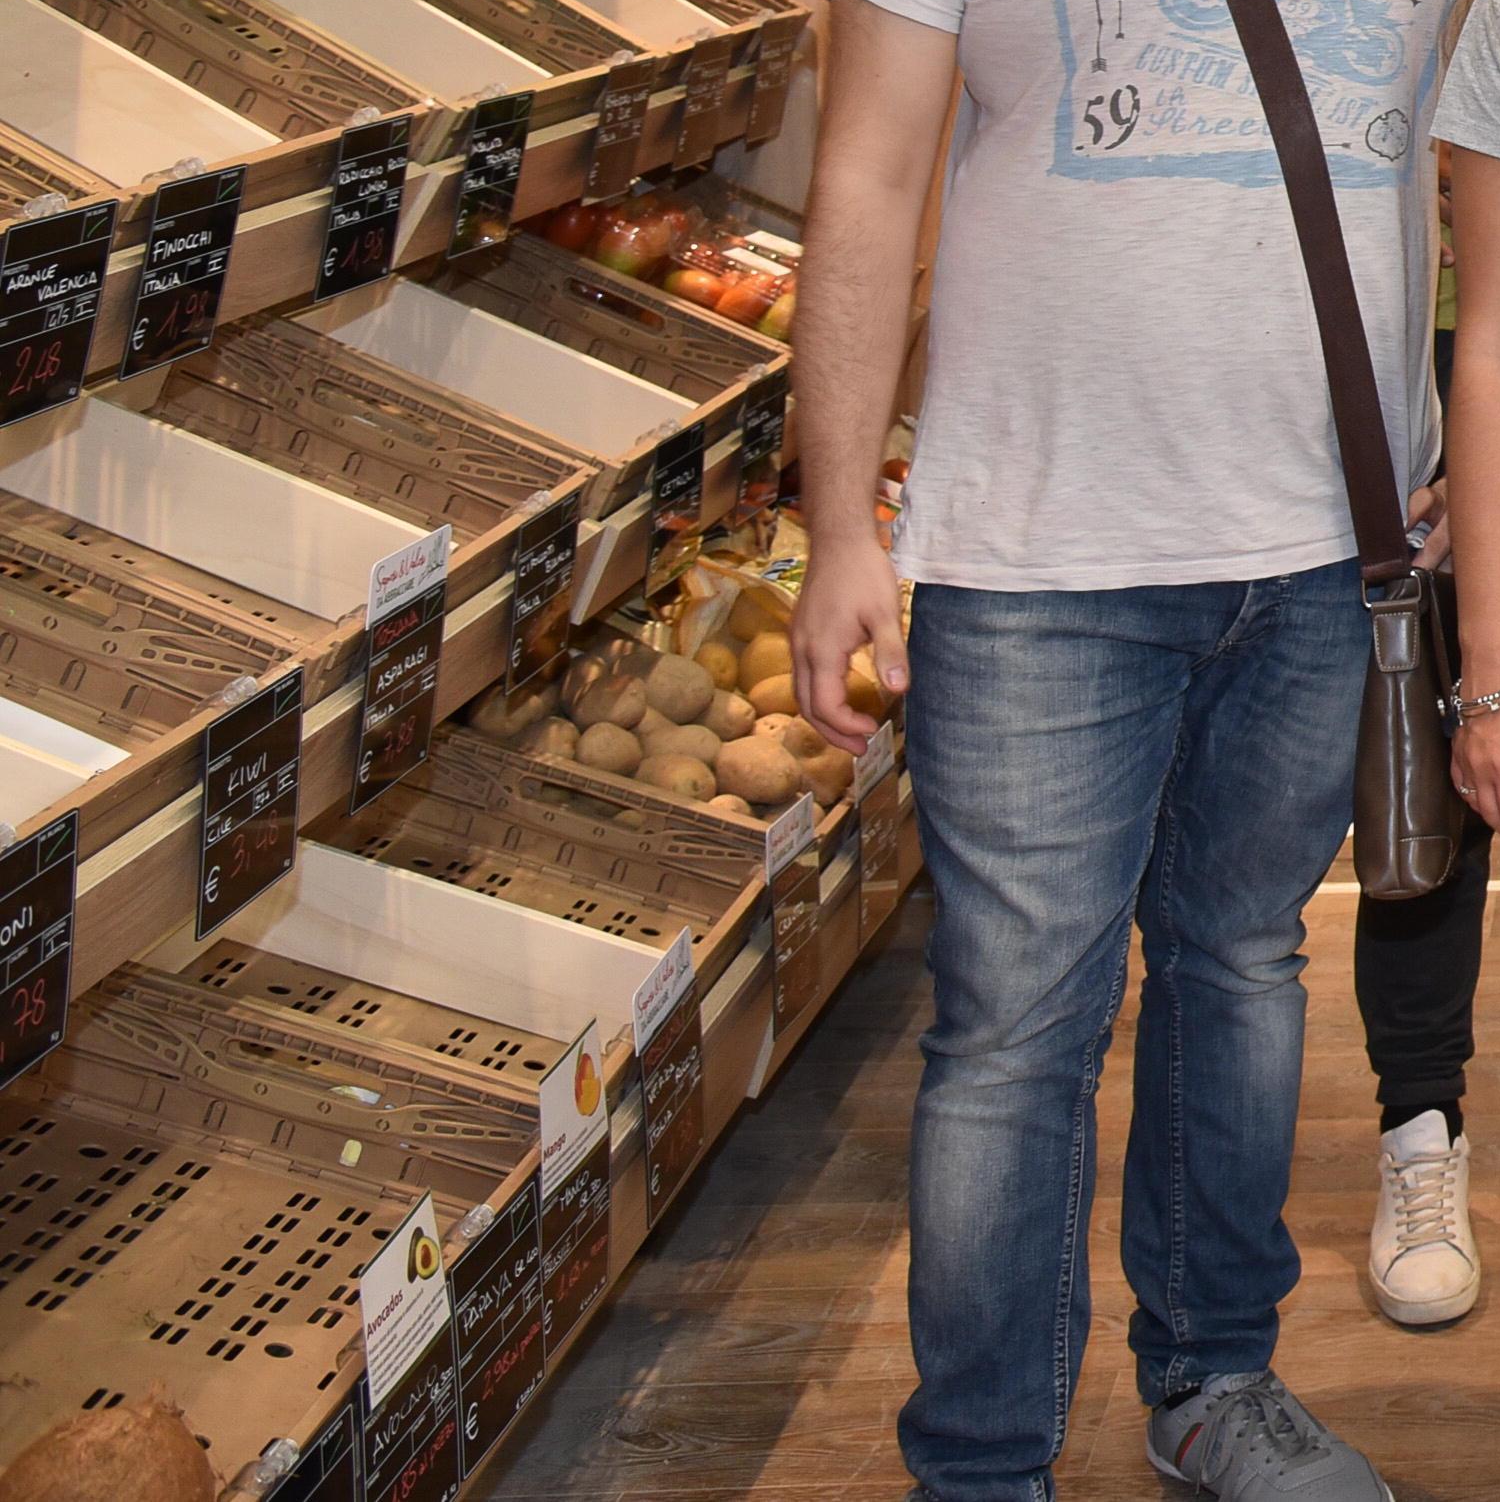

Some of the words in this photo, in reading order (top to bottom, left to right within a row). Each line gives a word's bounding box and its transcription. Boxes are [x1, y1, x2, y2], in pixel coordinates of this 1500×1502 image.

[152, 230, 213, 263] FINOCCHI
[323, 247, 339, 278] €
[6, 263, 60, 295] ARANCE
[131, 317, 150, 351] €
[8, 340, 63, 397] 2,48
[375, 644, 429, 696] ASPARAGI
[227, 751, 268, 798] KIWI
[359, 749, 373, 784] €
[207, 816, 233, 844] CILE
[204, 864, 221, 904] €
[543, 1132, 567, 1164] Mango
[366, 1289, 405, 1341] Avocados
[462, 1270, 513, 1337] PAPAYA
[372, 1363, 439, 1466] AVOCADO
[465, 1401, 480, 1442] €
